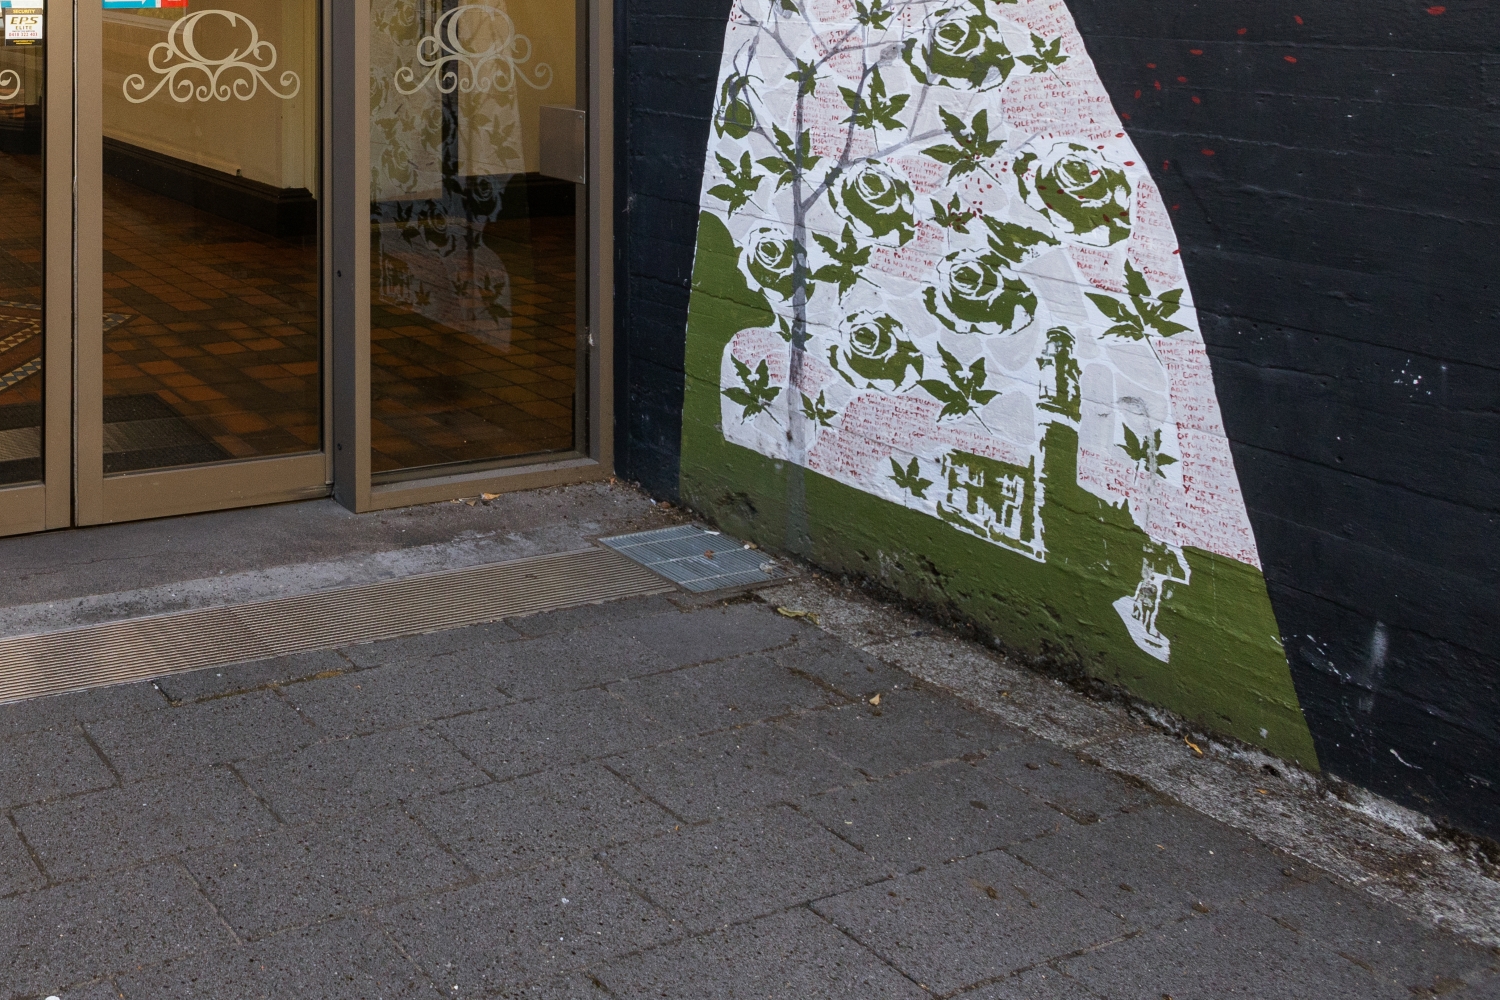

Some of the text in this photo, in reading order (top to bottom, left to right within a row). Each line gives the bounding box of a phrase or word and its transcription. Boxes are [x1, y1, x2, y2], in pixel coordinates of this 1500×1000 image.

[10, 16, 39, 25] EPS
[1088, 130, 1112, 140] TIMES
[1107, 483, 1130, 497] SMILE
